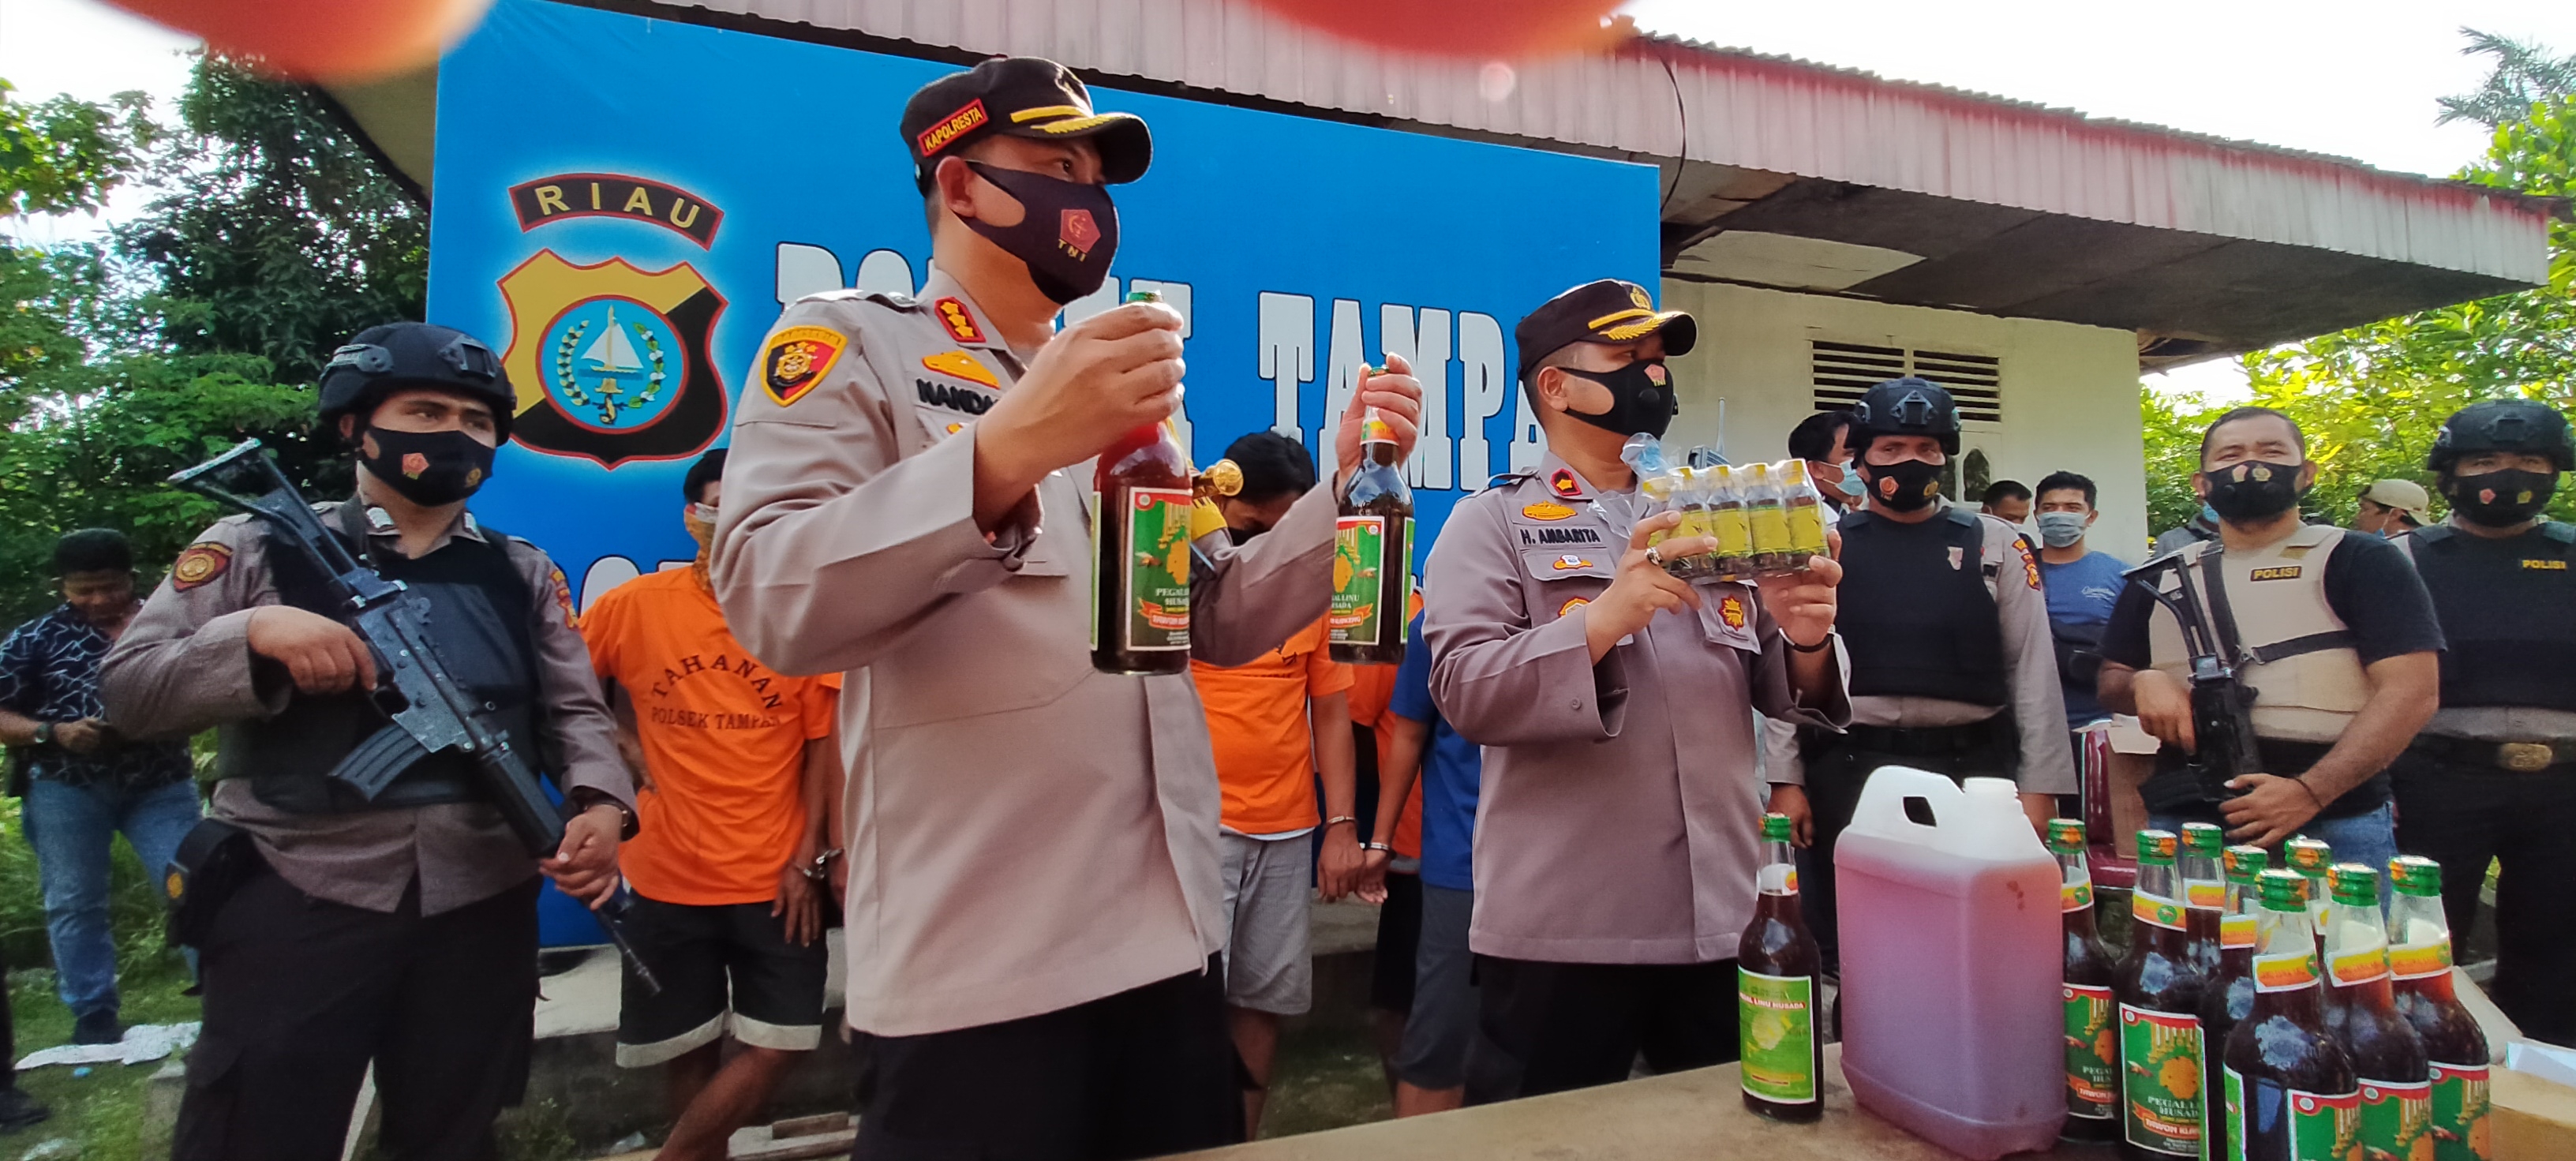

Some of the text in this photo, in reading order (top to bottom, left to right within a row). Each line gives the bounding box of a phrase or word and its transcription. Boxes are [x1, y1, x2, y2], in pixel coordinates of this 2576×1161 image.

[924, 107, 983, 152] KAPOLRESTA
[534, 182, 701, 229] RIAU
[1058, 238, 1087, 262] TNI
[1520, 528, 1601, 545] H. AMBARITA
[2254, 567, 2298, 579] POLISI
[2522, 560, 2567, 569] POLISI
[652, 654, 782, 709] TAHANAN
[652, 707, 709, 728] POLSEK
[2147, 1095, 2185, 1109] PEGAL
[2145, 1118, 2177, 1134] TAWON
